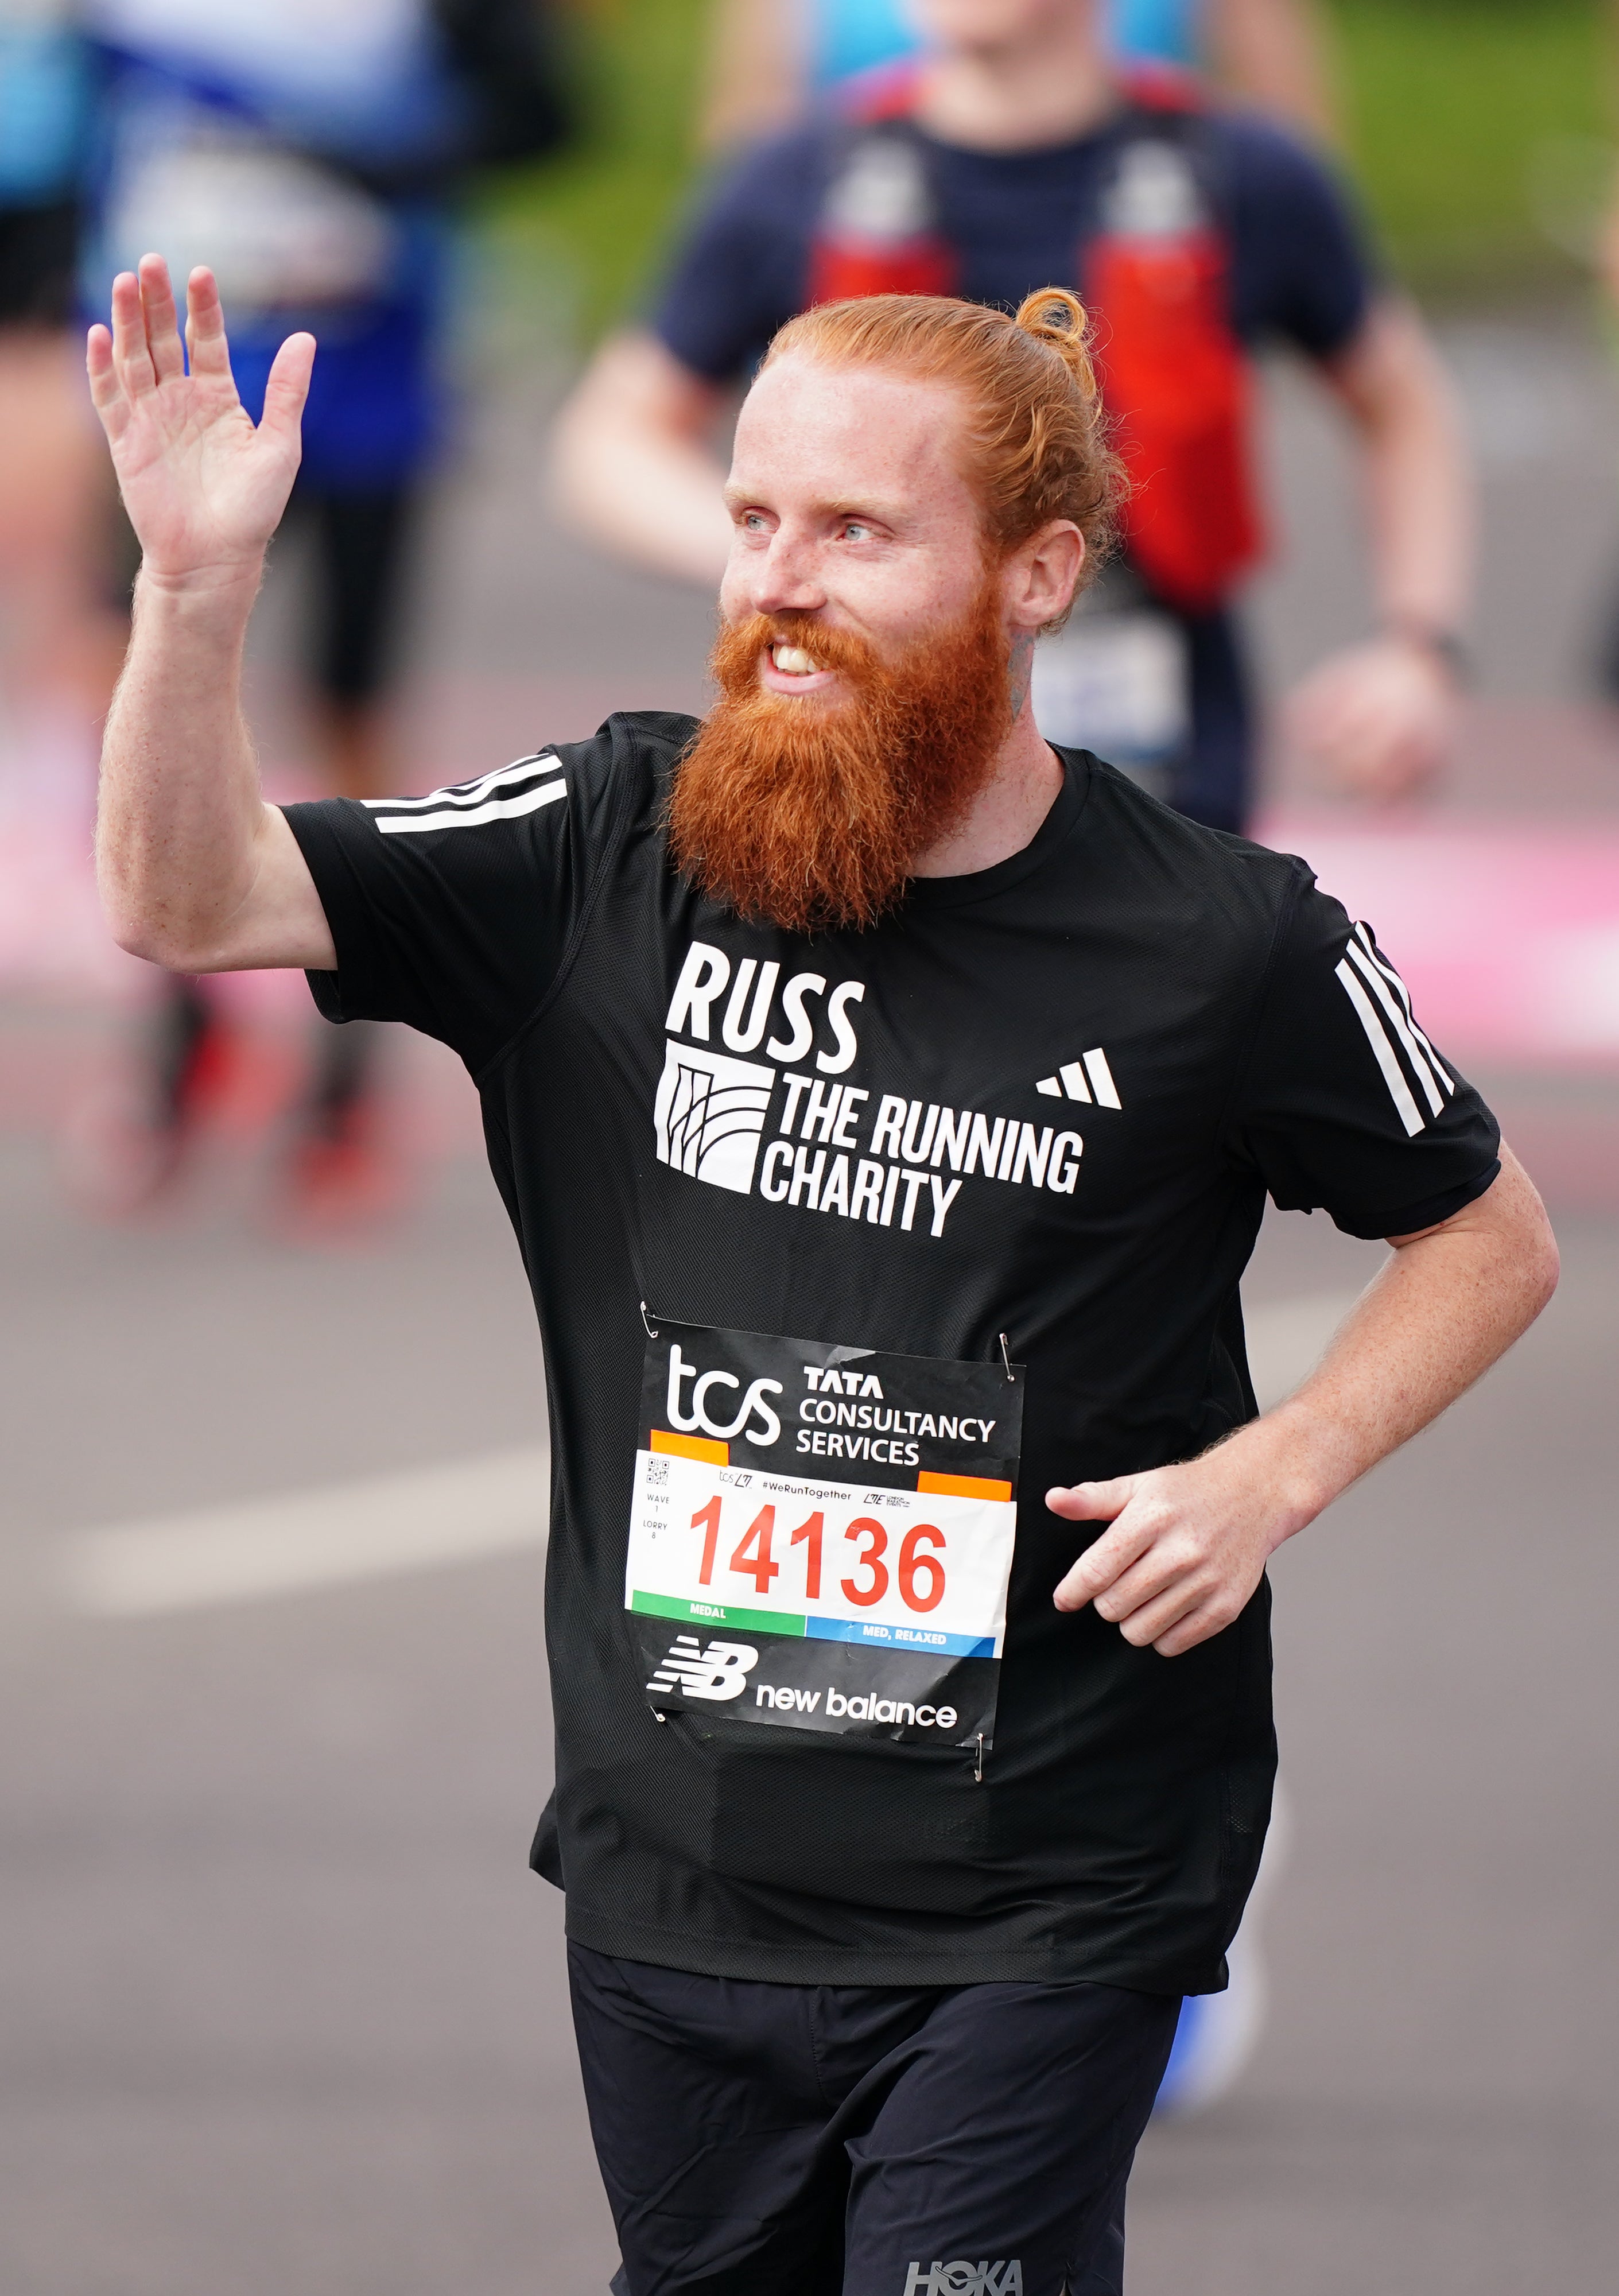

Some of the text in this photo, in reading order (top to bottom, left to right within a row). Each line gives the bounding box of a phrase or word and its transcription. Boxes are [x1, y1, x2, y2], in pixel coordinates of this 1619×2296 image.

[665, 941, 865, 1075] RUSS
[779, 1072, 1084, 1194] THE RUNNING
[760, 1141, 963, 1238] CHARITY
[667, 1344, 783, 1446] tcs
[803, 1366, 884, 1399] TATA
[799, 1398, 996, 1442] CONSULTANCY
[795, 1429, 919, 1466] SERVICES
[647, 1494, 669, 1504] WAVE
[763, 1481, 852, 1500] #WeRunTogether
[643, 1520, 667, 1530] LORRY
[690, 1495, 946, 1613] 14136
[690, 1603, 727, 1619] MEDAL
[863, 1625, 946, 1645] MED, RELAXED
[756, 1684, 957, 1729] new balance
[903, 2260, 1023, 2296] HOKA
